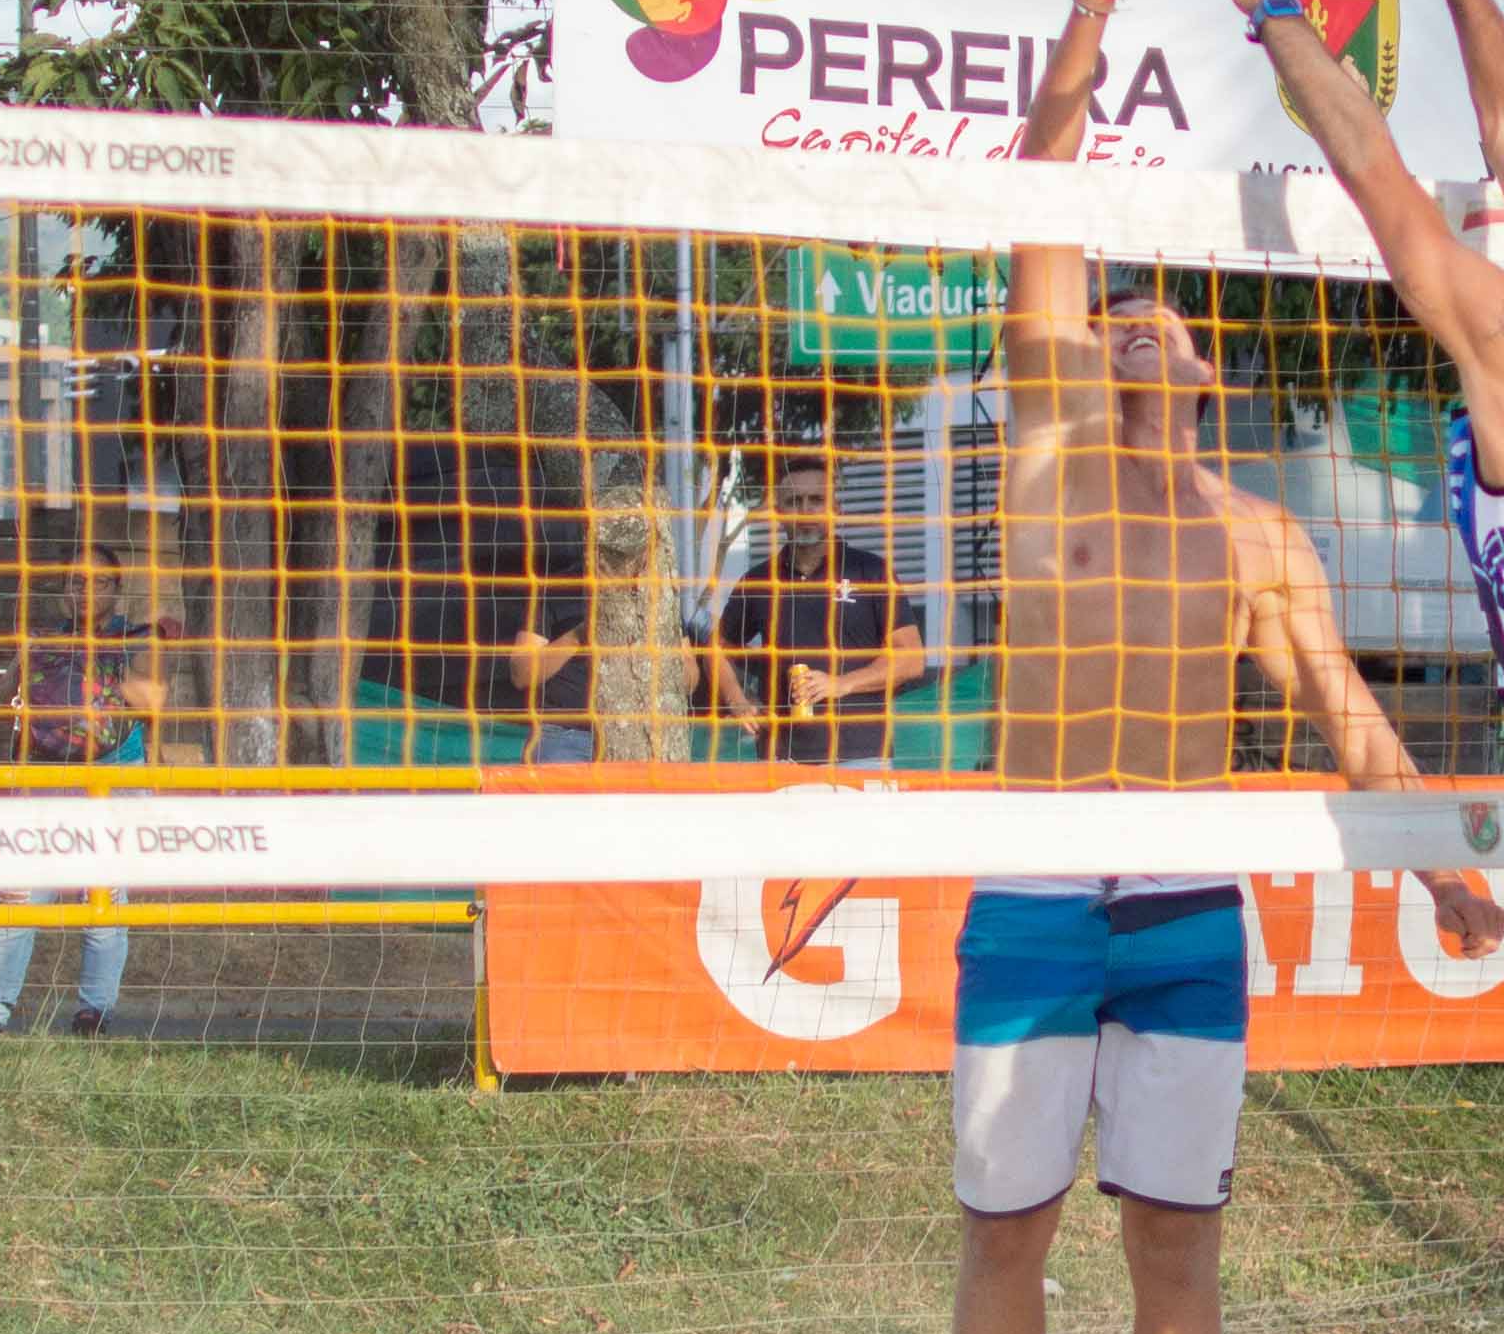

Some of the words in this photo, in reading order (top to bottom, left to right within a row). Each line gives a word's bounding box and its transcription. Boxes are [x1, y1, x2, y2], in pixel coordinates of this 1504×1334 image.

[80, 142, 97, 170] Y
[108, 144, 235, 176] DEPORTE
[105, 827, 124, 854] Y
[138, 824, 268, 854] DEPORTE
